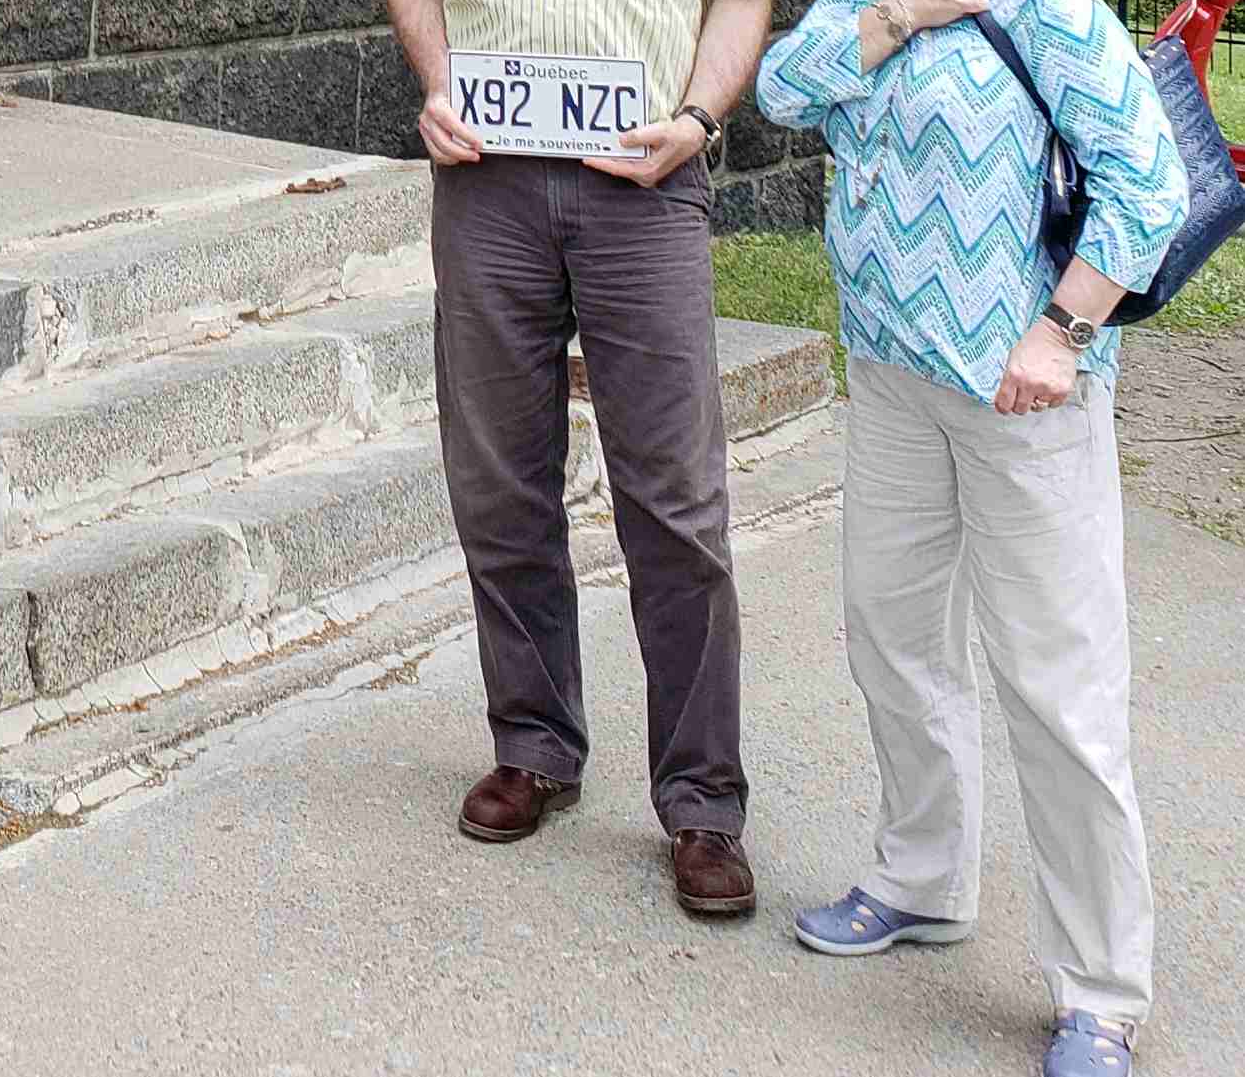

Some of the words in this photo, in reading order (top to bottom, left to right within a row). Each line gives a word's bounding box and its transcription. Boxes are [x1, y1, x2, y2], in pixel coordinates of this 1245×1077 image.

[523, 63, 589, 81] Québec
[458, 77, 533, 128] X92
[561, 82, 639, 134] NZC
[495, 134, 511, 145] Je
[515, 138, 535, 148] me
[538, 138, 602, 153] souviens
